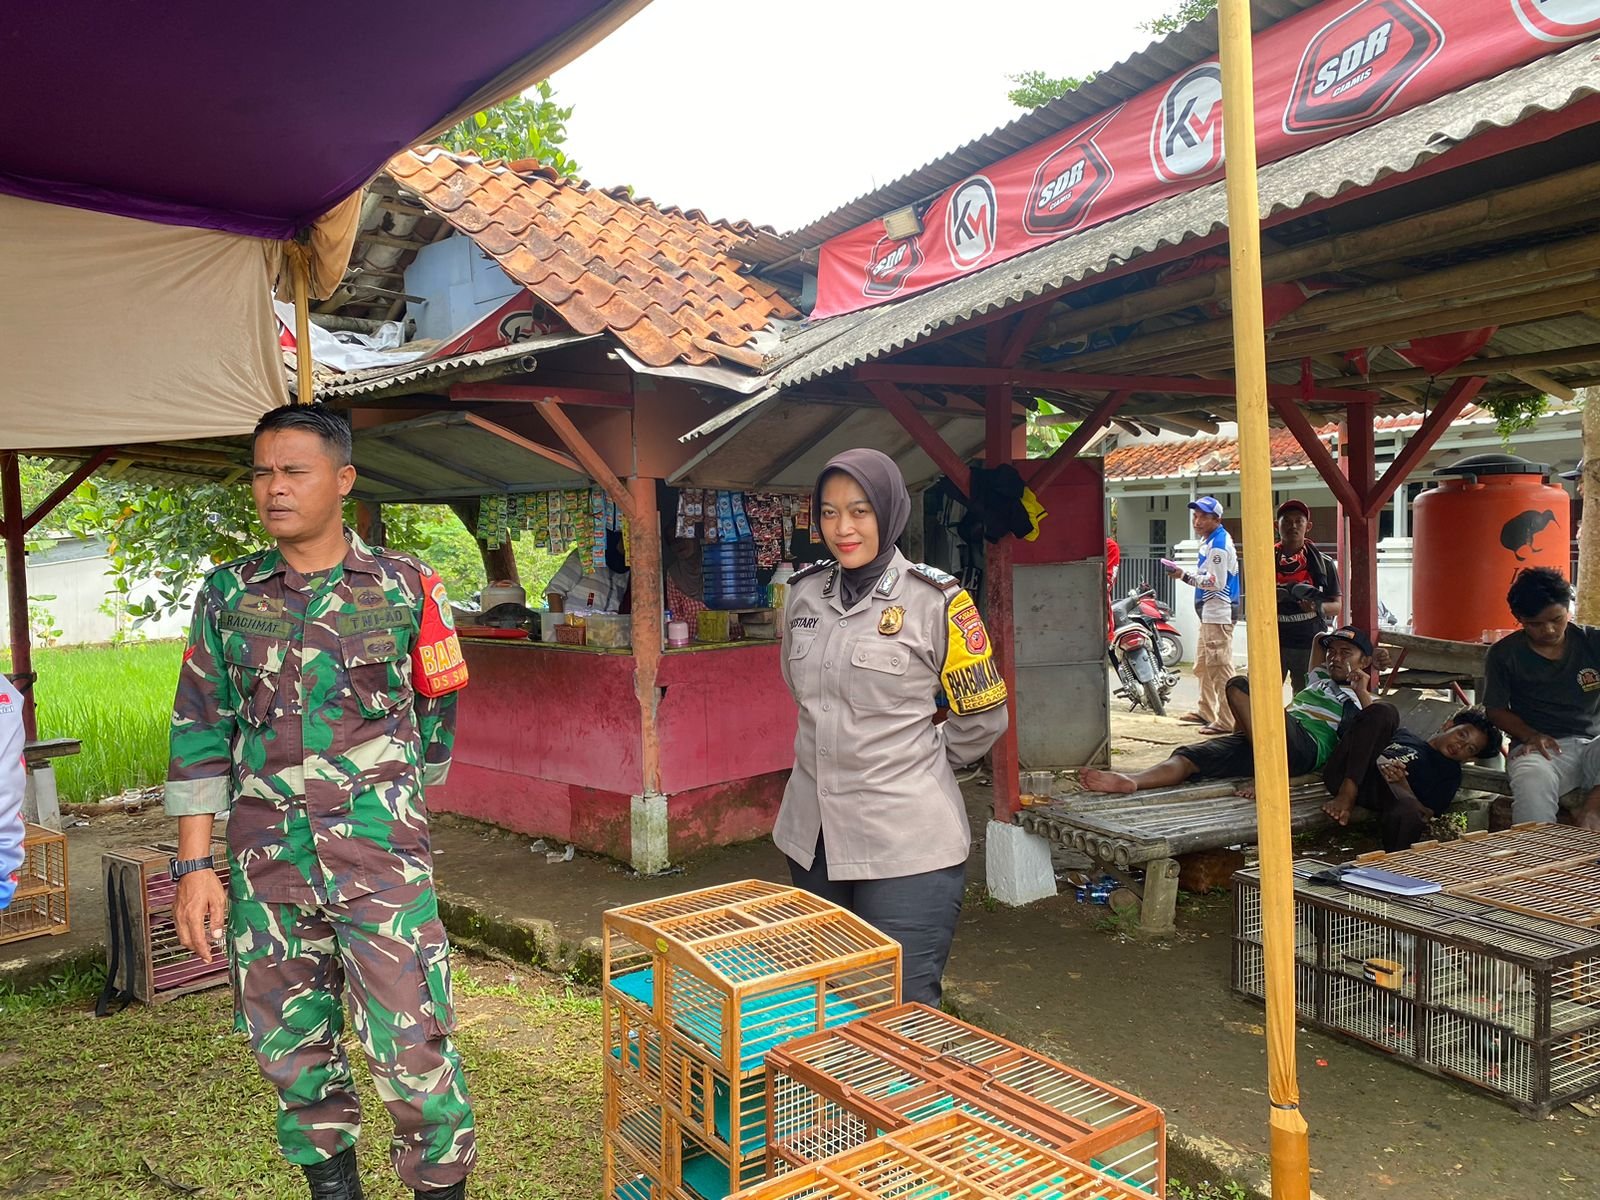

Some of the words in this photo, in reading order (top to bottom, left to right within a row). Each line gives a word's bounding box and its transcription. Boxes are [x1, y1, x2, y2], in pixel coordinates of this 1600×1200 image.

[1313, 22, 1392, 95] SDR
[1332, 68, 1373, 97] CIAMIS
[1038, 159, 1086, 208] SDR
[954, 200, 988, 246] KM
[873, 243, 907, 276] SDR
[226, 615, 280, 634] RACHMAT
[351, 609, 403, 630] TNI-AD
